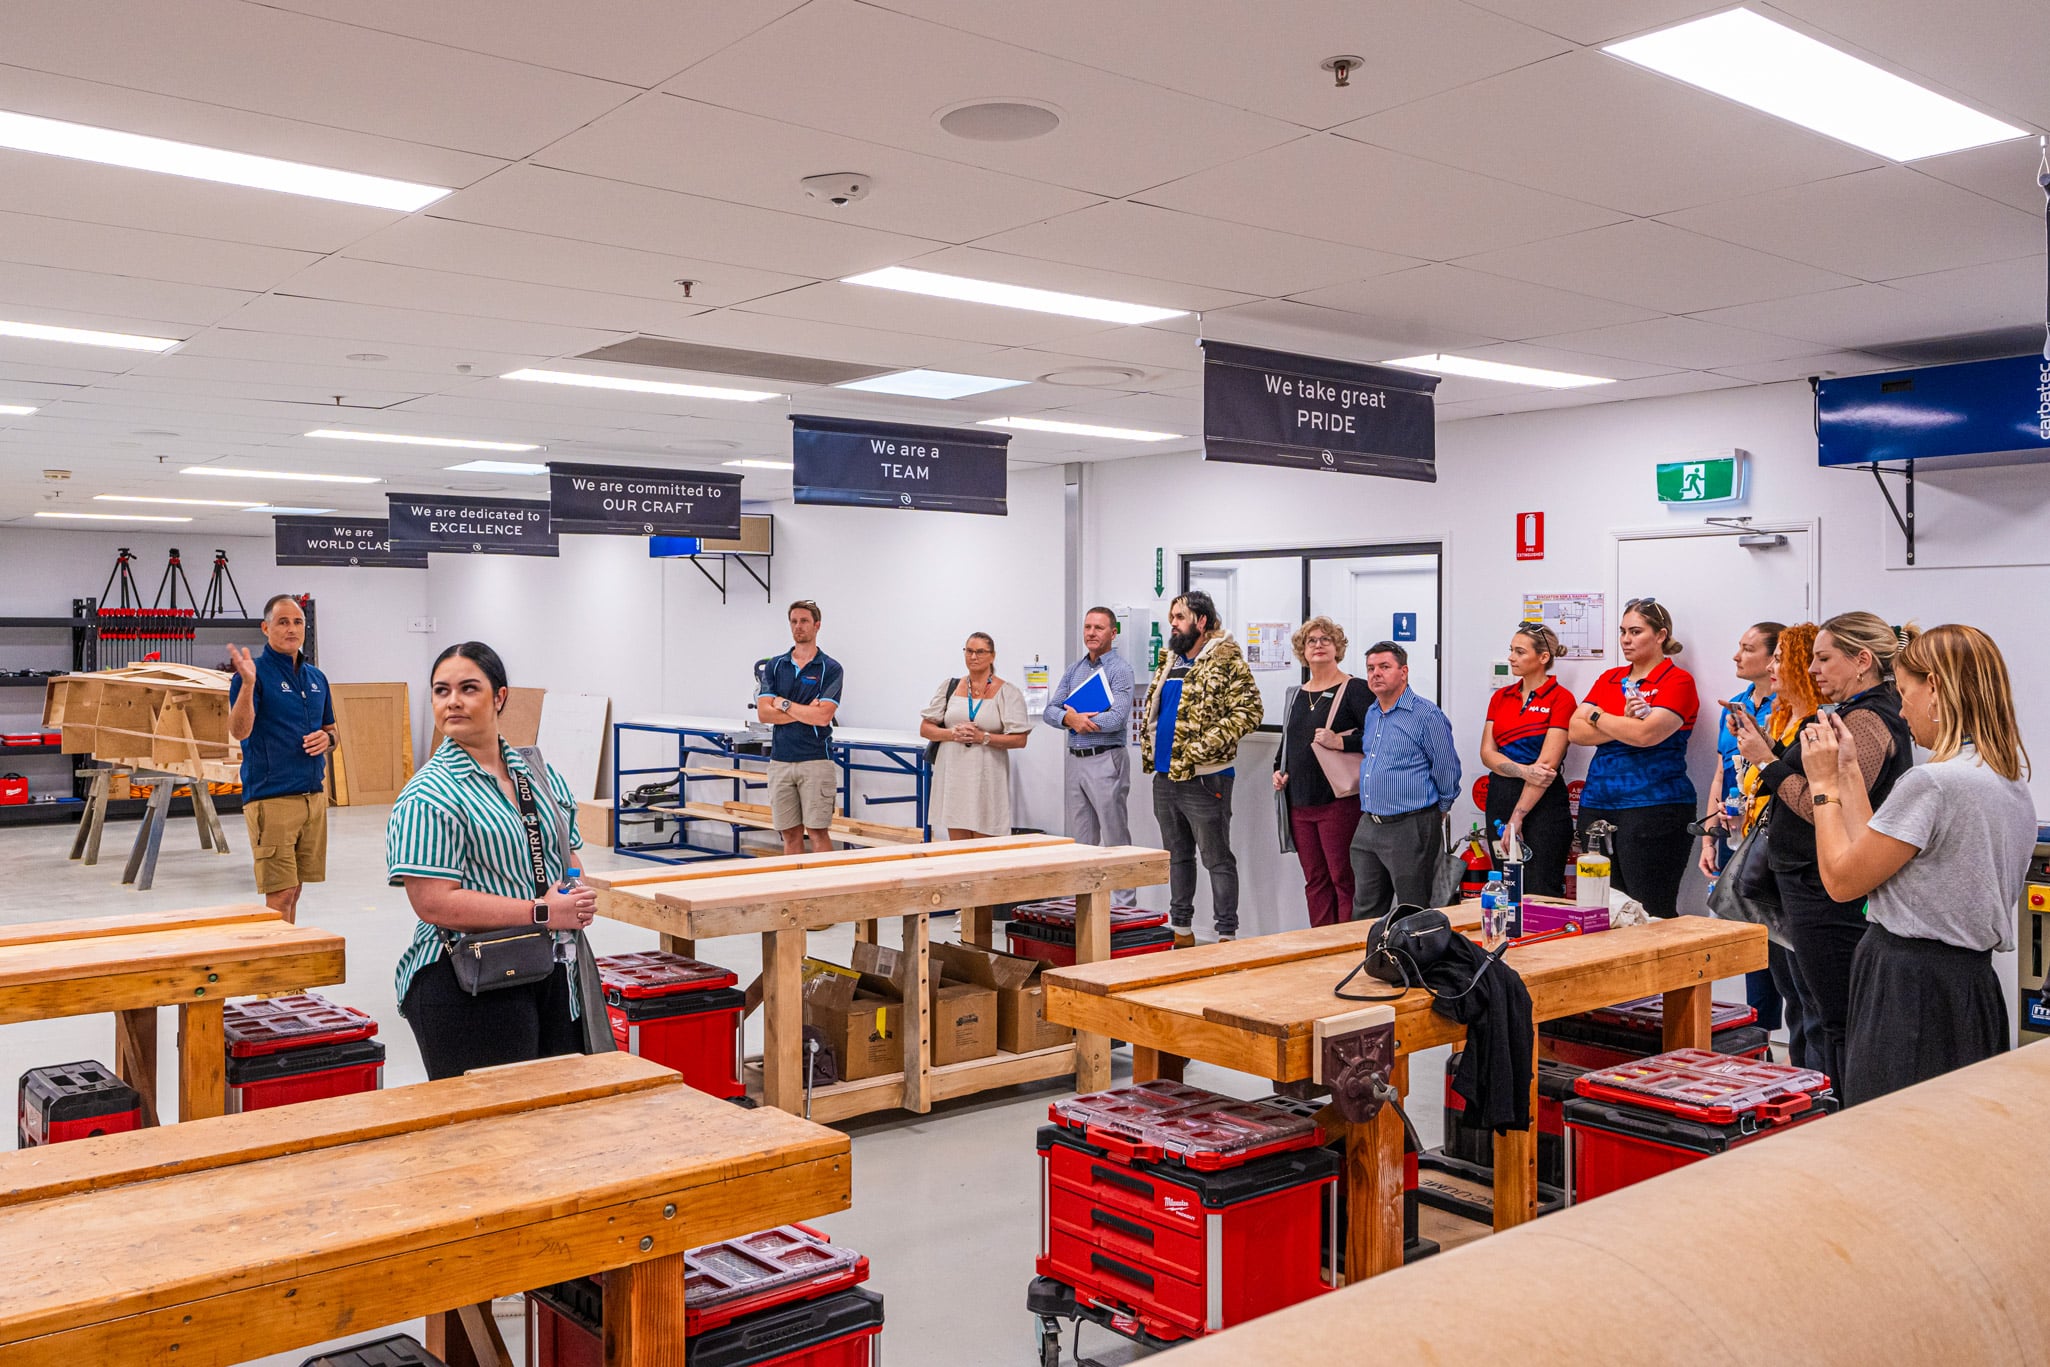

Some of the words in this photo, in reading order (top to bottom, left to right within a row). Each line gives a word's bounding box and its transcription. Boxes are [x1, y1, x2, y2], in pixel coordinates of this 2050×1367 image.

[1265, 374, 1292, 395] We
[1298, 380, 1336, 401] take
[1341, 389, 1386, 409] great
[1297, 409, 1356, 434] PRIDE
[871, 439, 895, 455] We
[900, 445, 925, 458] are
[931, 448, 939, 459] a
[881, 463, 929, 480] TEAM
[572, 478, 595, 492] We
[600, 482, 623, 494] are
[627, 483, 703, 498] committed
[707, 486, 722, 498] to
[411, 505, 432, 517] We
[435, 509, 456, 518] are
[460, 508, 524, 521] dedicated
[527, 511, 540, 521] to
[603, 498, 637, 513] OUR
[642, 501, 694, 514] CRAFT
[334, 527, 352, 537] We
[354, 530, 374, 538] are
[430, 522, 523, 536] EXCELLENCE
[307, 540, 355, 550] WORLD
[528, 828, 545, 883] COUNTRY
